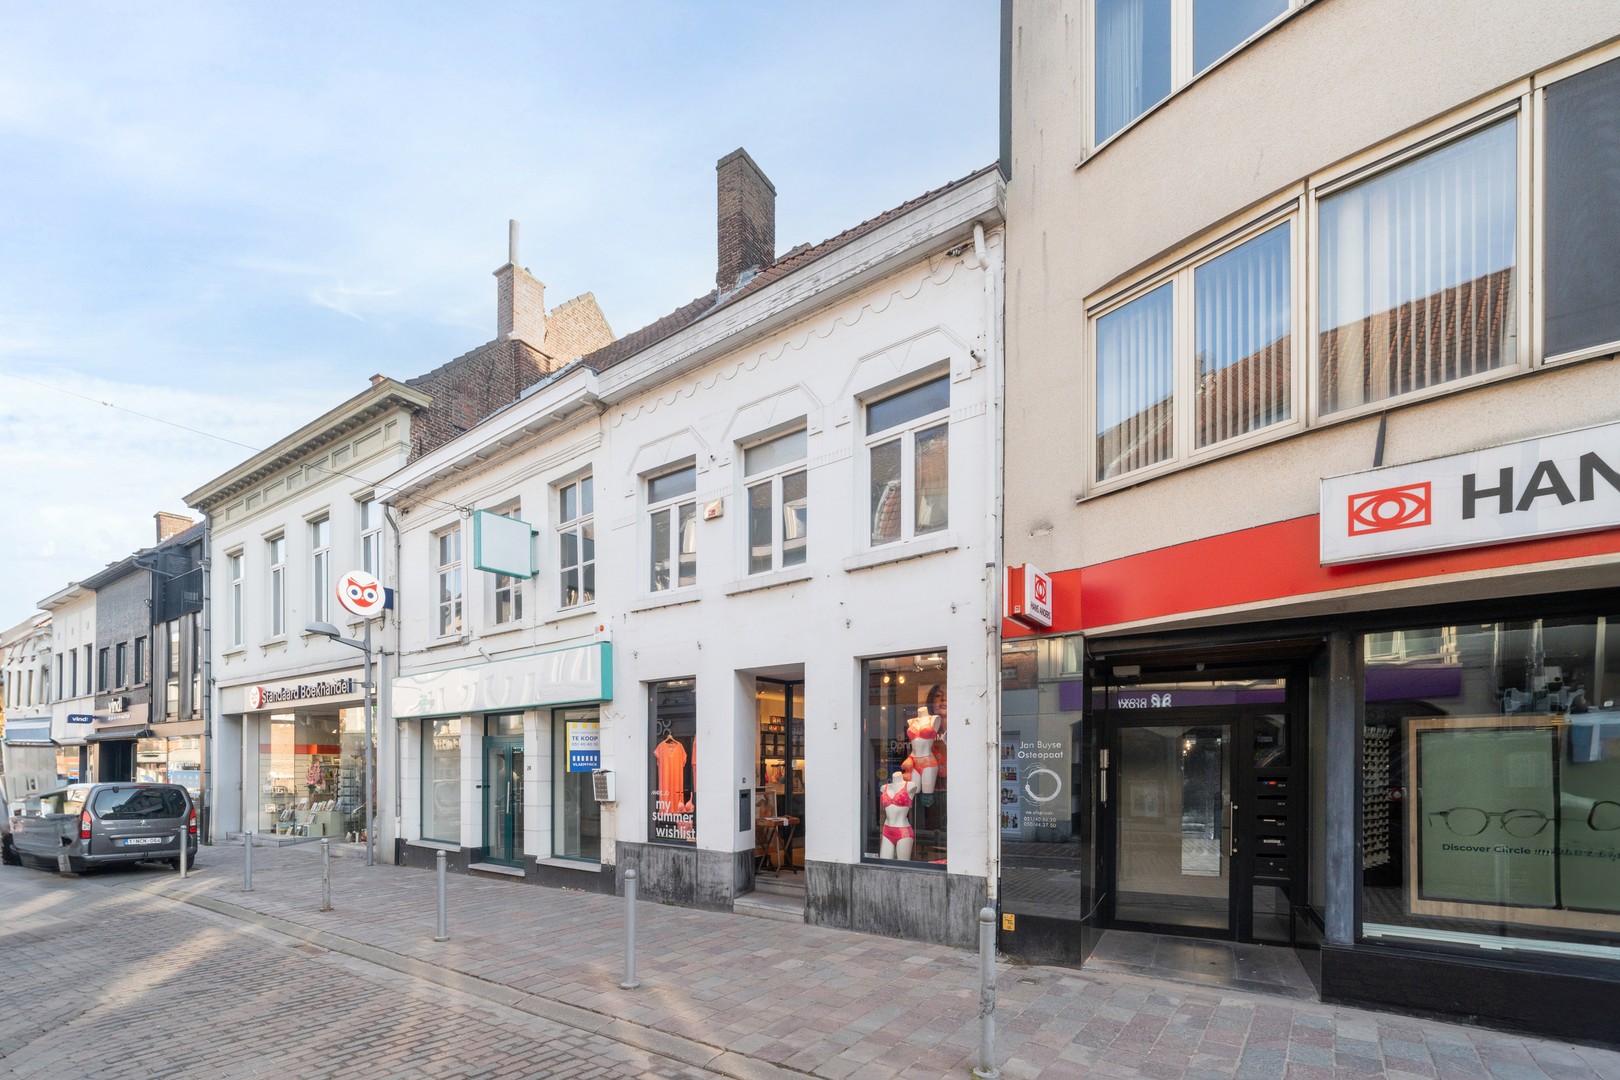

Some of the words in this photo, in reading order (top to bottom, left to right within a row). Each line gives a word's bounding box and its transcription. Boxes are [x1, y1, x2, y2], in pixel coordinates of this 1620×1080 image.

[262, 686, 302, 704] Standaard
[300, 677, 352, 699] Boekhandel
[1019, 741, 1035, 749] Jan
[1037, 741, 1062, 751] Buyse
[1017, 751, 1064, 761] Osteopaat
[655, 800, 671, 813] my
[652, 811, 694, 823] summer
[656, 824, 696, 840] wishlist
[1442, 843, 1490, 853] Discover
